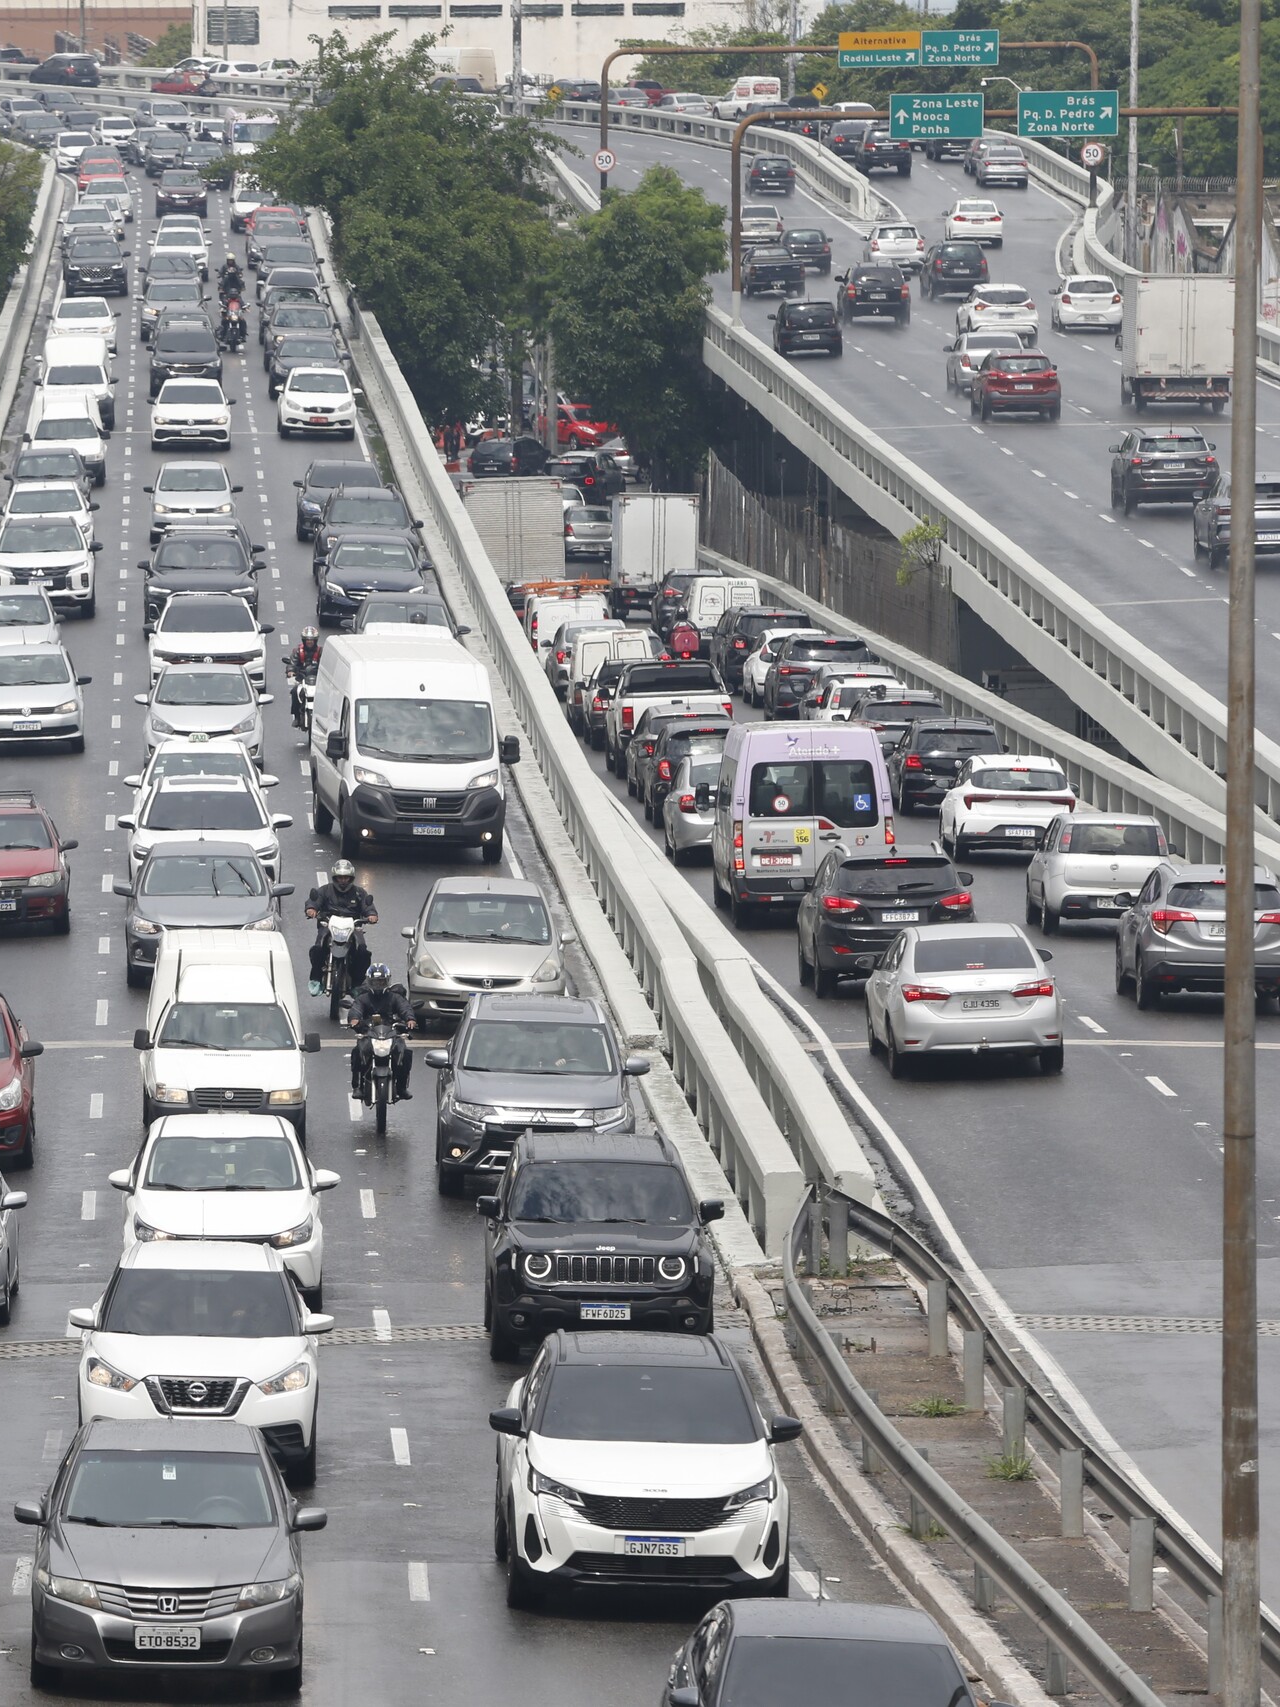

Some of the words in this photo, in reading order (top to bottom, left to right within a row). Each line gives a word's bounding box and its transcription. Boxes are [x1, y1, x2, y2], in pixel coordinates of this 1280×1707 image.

[853, 37, 907, 45] Alternativa
[959, 34, 981, 42] Brás
[925, 45, 939, 53] Pq.
[954, 44, 981, 52] Pedro
[843, 54, 873, 62] Radial
[876, 54, 901, 62] Leste
[928, 54, 951, 62] Zona
[955, 54, 981, 62] Norte
[913, 99, 942, 109] Zona
[946, 99, 979, 108] Leste
[1067, 96, 1095, 105] Brás
[913, 112, 950, 121] Mooca
[1023, 110, 1040, 121] Pq.
[1045, 110, 1056, 119] D.
[1060, 109, 1095, 119] Pedro
[913, 125, 950, 134] Penha
[1027, 122, 1057, 132] Zona
[1061, 122, 1095, 131] Norte
[1085, 149, 1099, 158] 50
[598, 155, 611, 165] 50
[423, 798, 437, 808] FIAT
[630, 1542, 679, 1555] GJN7G35
